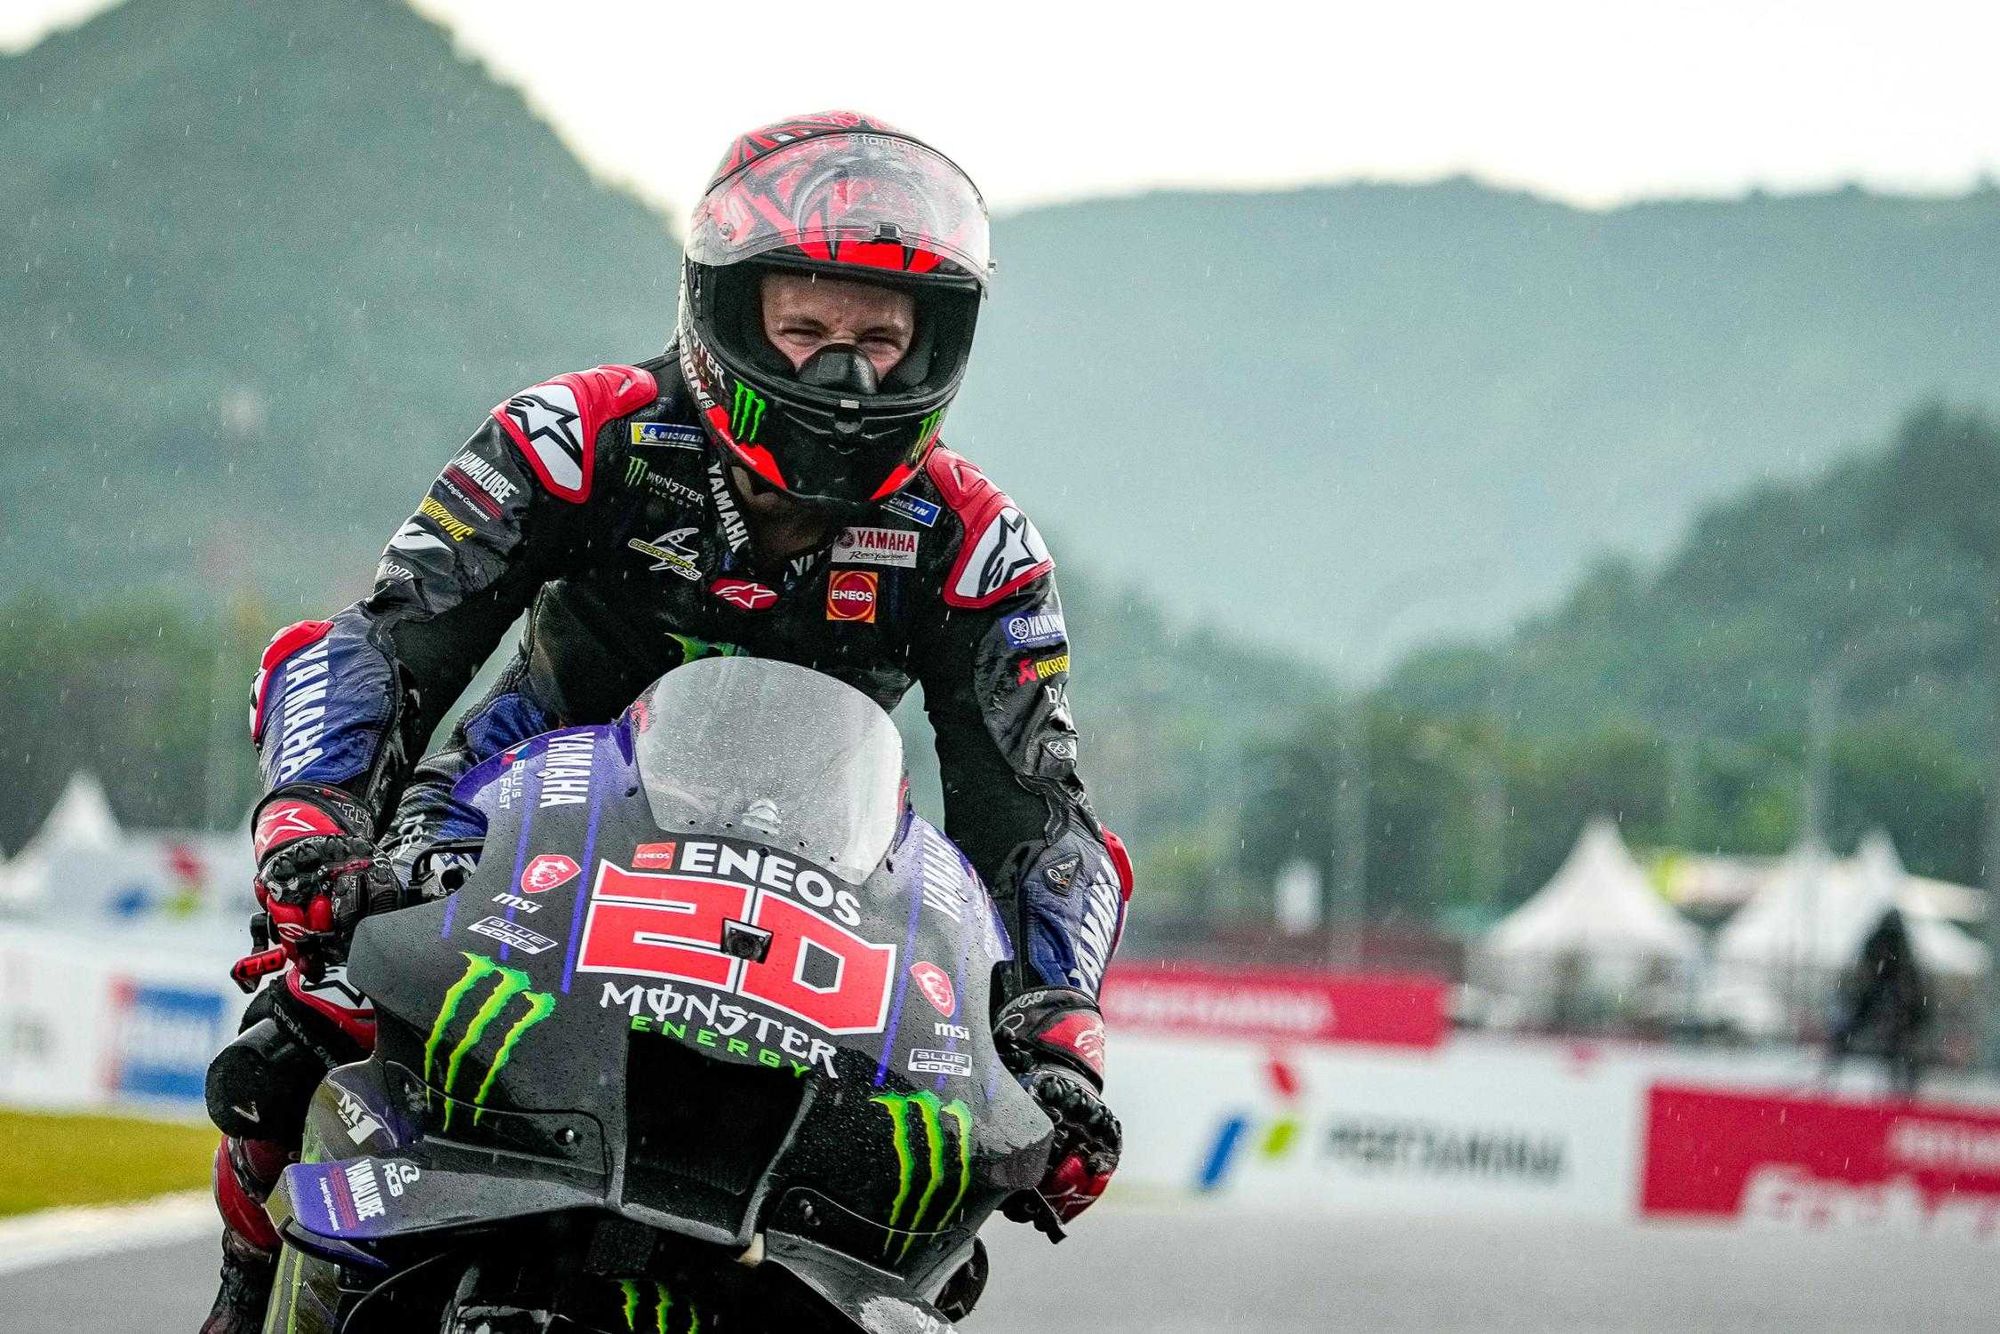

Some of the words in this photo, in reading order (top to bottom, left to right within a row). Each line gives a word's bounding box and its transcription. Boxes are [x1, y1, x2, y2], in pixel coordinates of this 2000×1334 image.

[454, 450, 517, 505] YAMALUBE
[646, 471, 705, 507] MONSTER
[888, 497, 931, 517] CHELIN
[630, 540, 694, 570] SCORPION
[857, 530, 915, 553] YAMAHA
[831, 590, 873, 602] ENEOS
[281, 638, 329, 782] YAMAHA
[512, 759, 525, 785] BLU
[540, 732, 595, 808] YAMAHA
[679, 842, 861, 927] ENEOS
[491, 892, 543, 914] msi
[476, 925, 533, 950] CORE
[488, 919, 548, 945] BLUE
[576, 859, 897, 1035] 20
[599, 981, 839, 1079] MONSTER
[934, 1022, 970, 1040] msi
[630, 1015, 811, 1078] ENERGY
[917, 1051, 966, 1064] BLUE
[917, 1062, 964, 1073] CORE
[337, 1094, 384, 1145] M1
[345, 1159, 386, 1222] YAMALUBE
[382, 1162, 404, 1197] RCB
